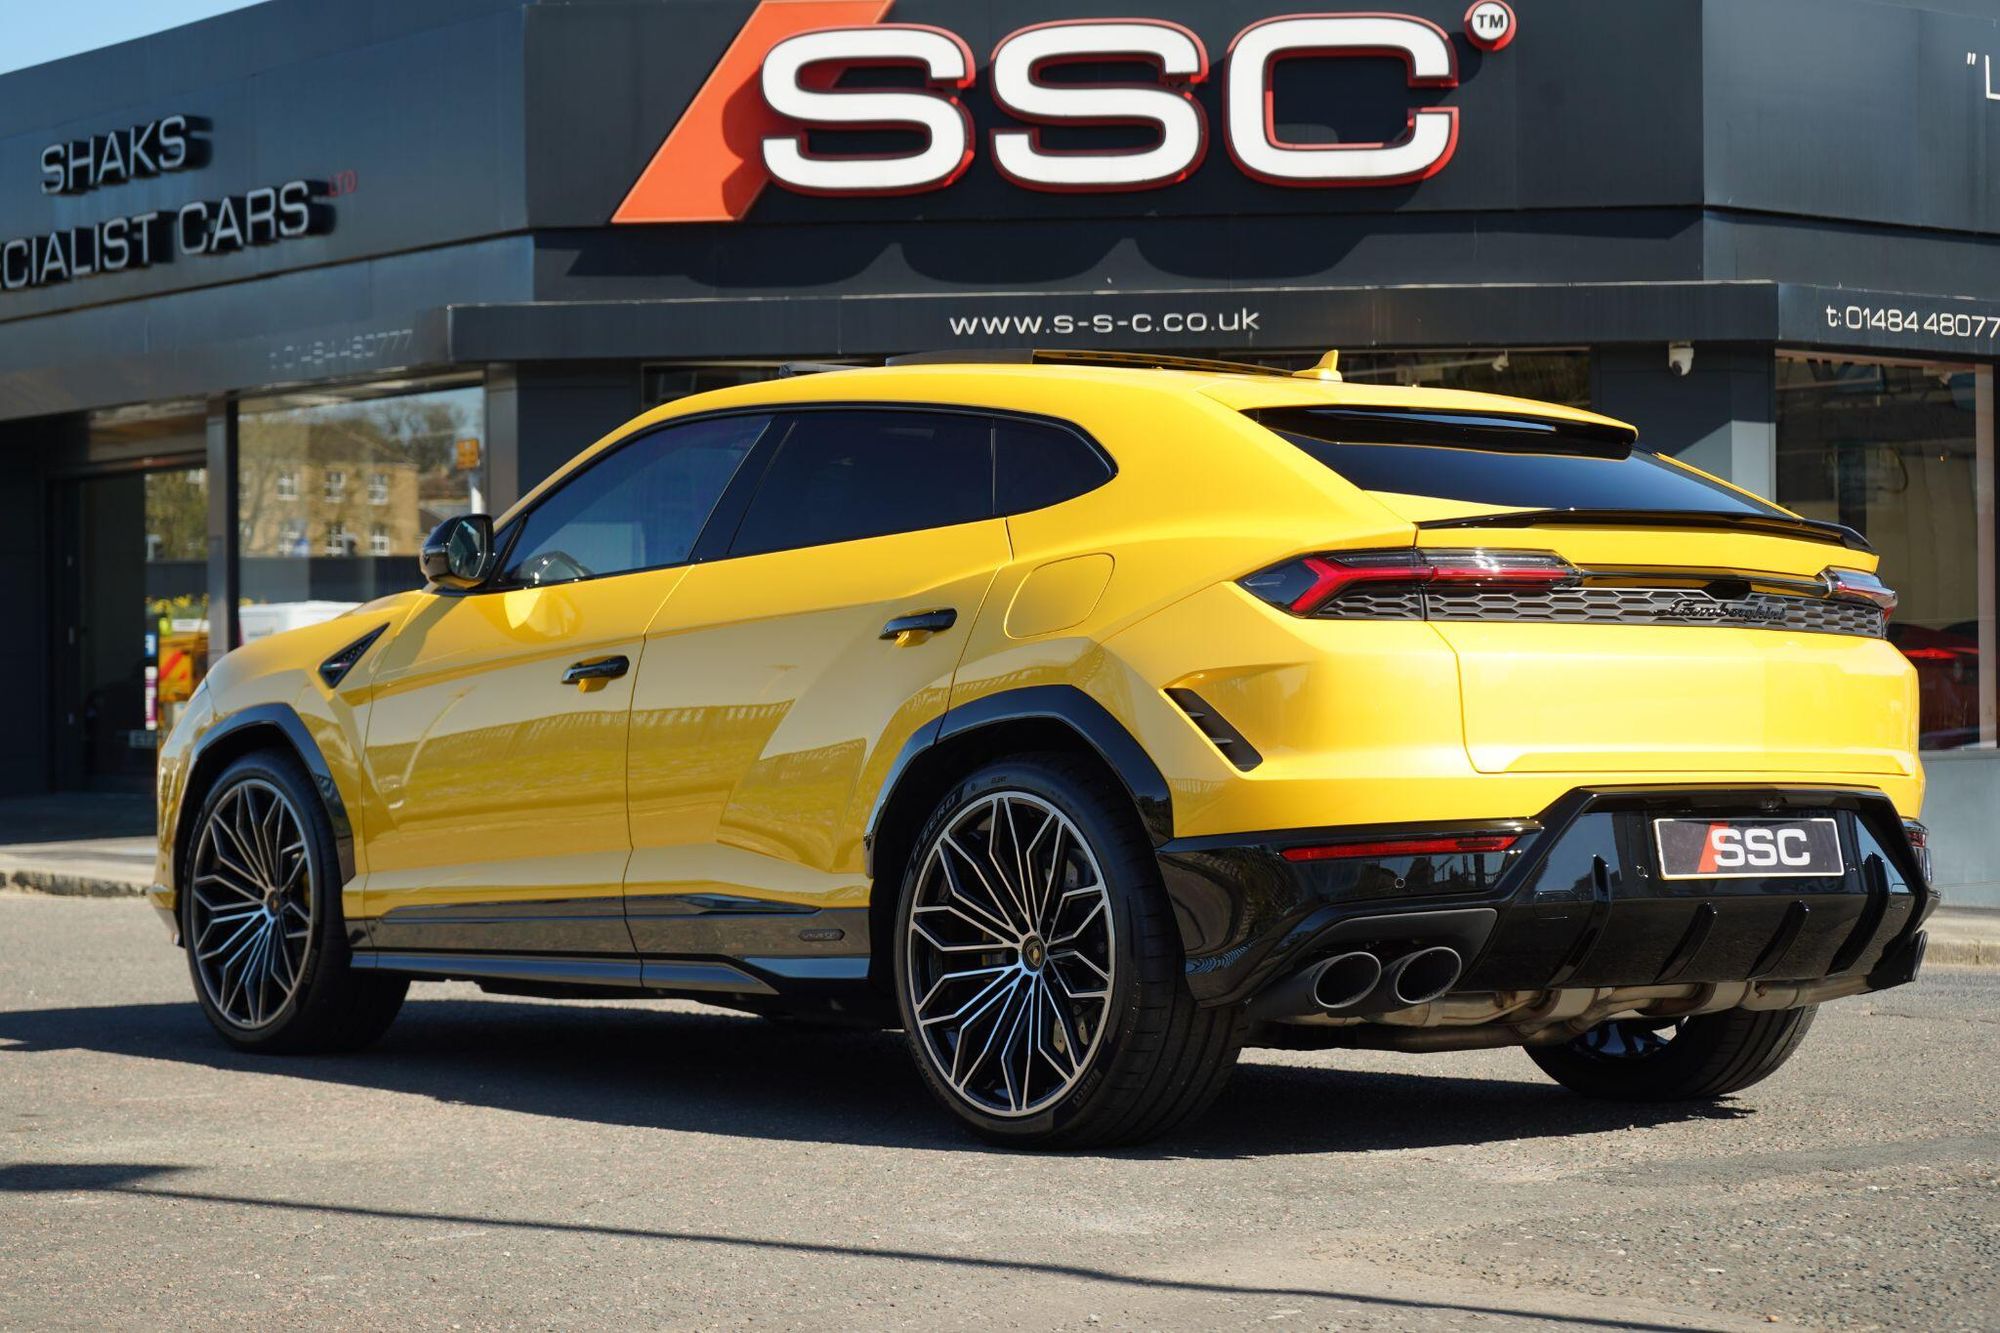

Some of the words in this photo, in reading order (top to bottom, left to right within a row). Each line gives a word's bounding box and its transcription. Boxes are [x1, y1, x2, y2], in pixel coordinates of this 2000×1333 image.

[1476, 14, 1504, 29] TM
[760, 15, 1456, 192] SSC
[40, 114, 187, 195] SHAKS
[178, 180, 309, 255] CARS
[329, 170, 358, 197] LTD
[949, 307, 1260, 336] www.s-s-c.co.uk
[1845, 305, 1919, 333] 01484
[1651, 598, 1787, 621] Lamborghini
[1710, 828, 1811, 867] SSC
